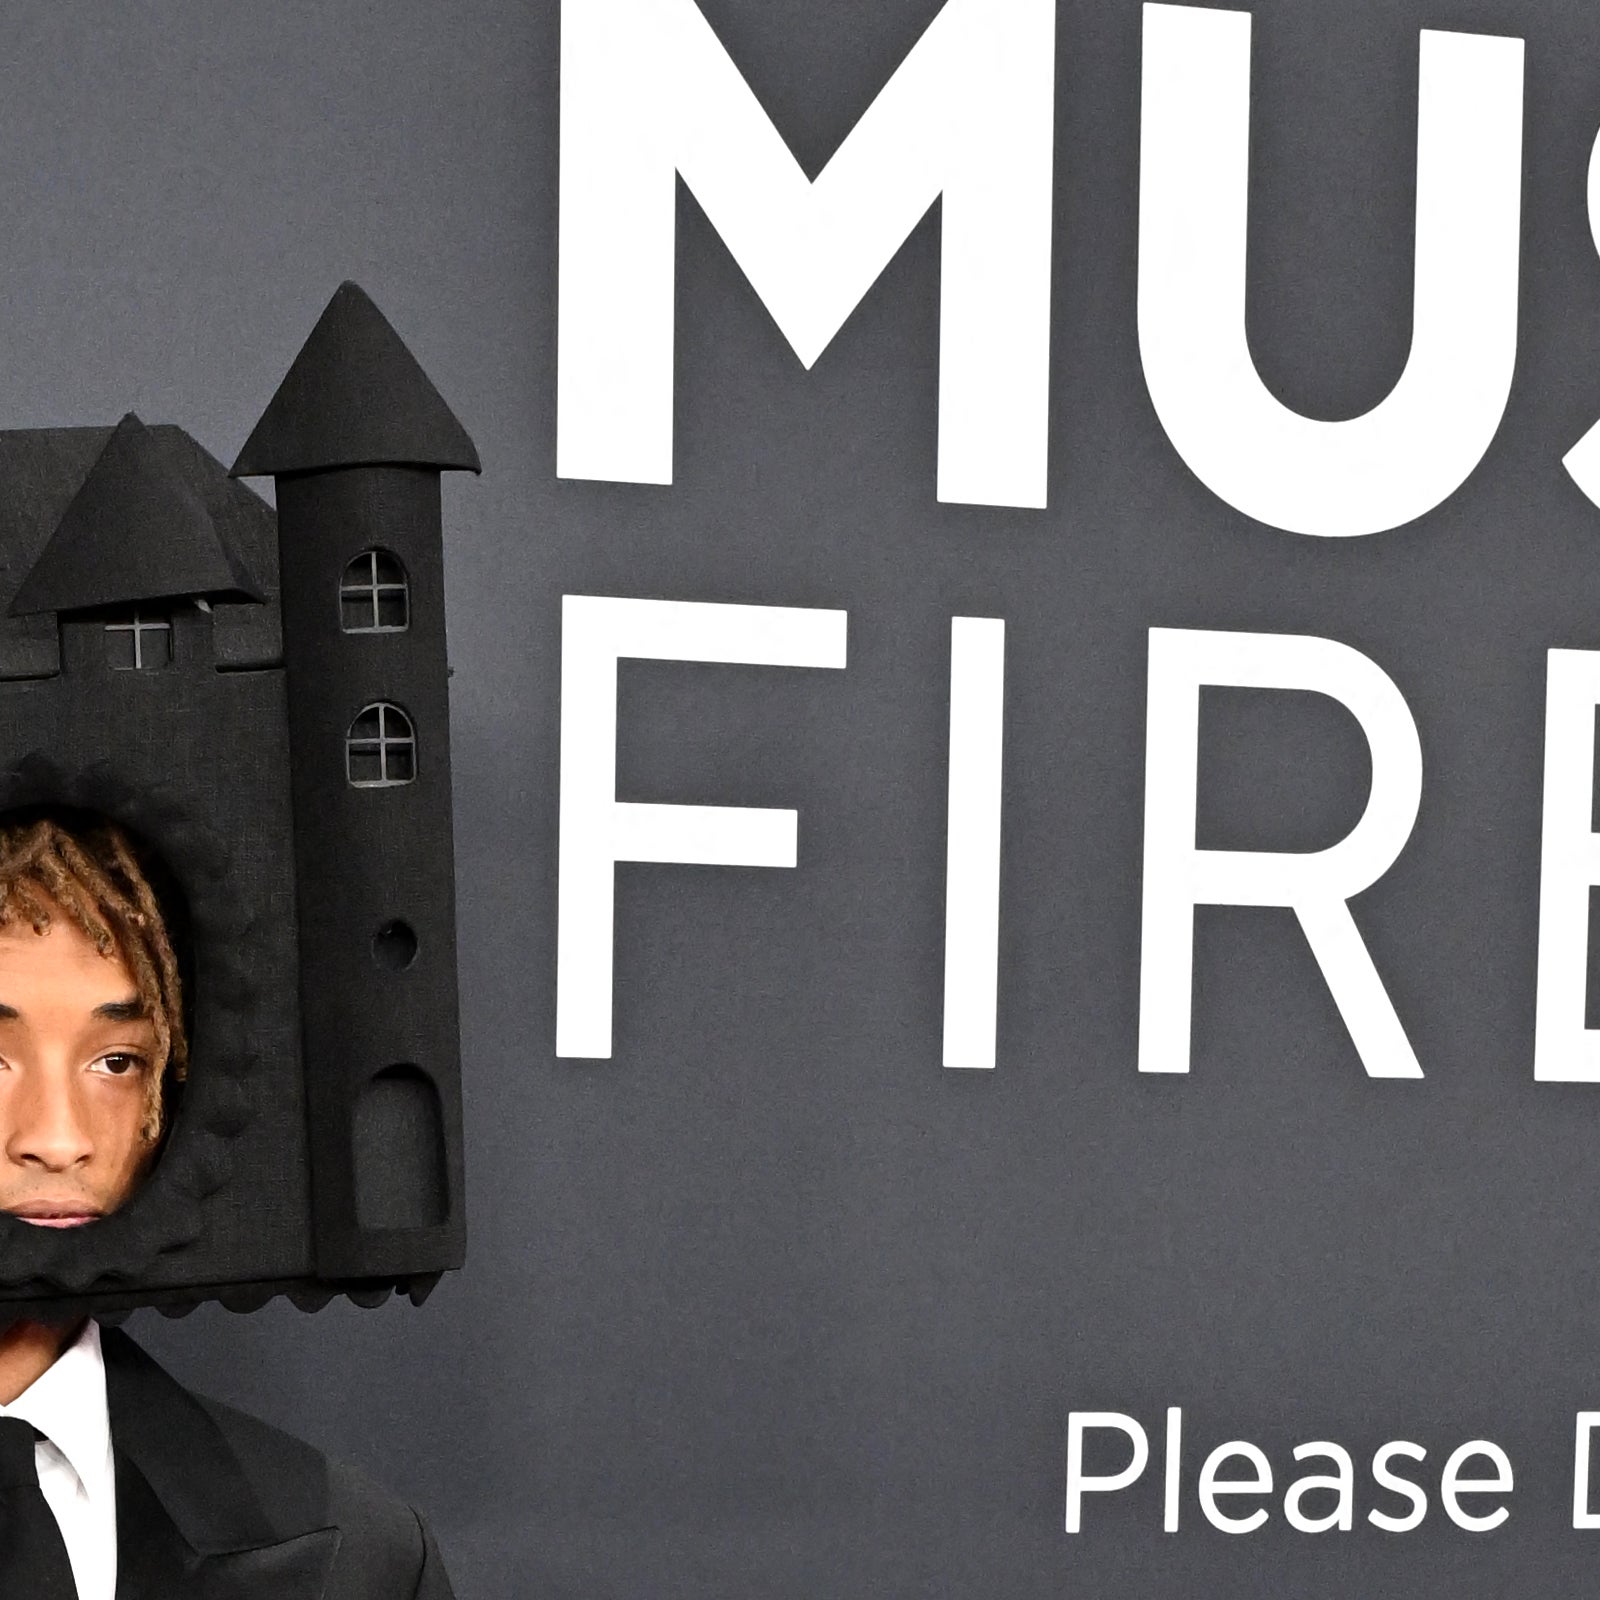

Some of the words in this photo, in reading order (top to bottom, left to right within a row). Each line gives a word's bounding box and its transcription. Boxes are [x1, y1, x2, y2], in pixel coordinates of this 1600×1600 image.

[556, 0, 1600, 538] MU
[555, 594, 1600, 1083] FIR
[1064, 1406, 1514, 1535] Please
